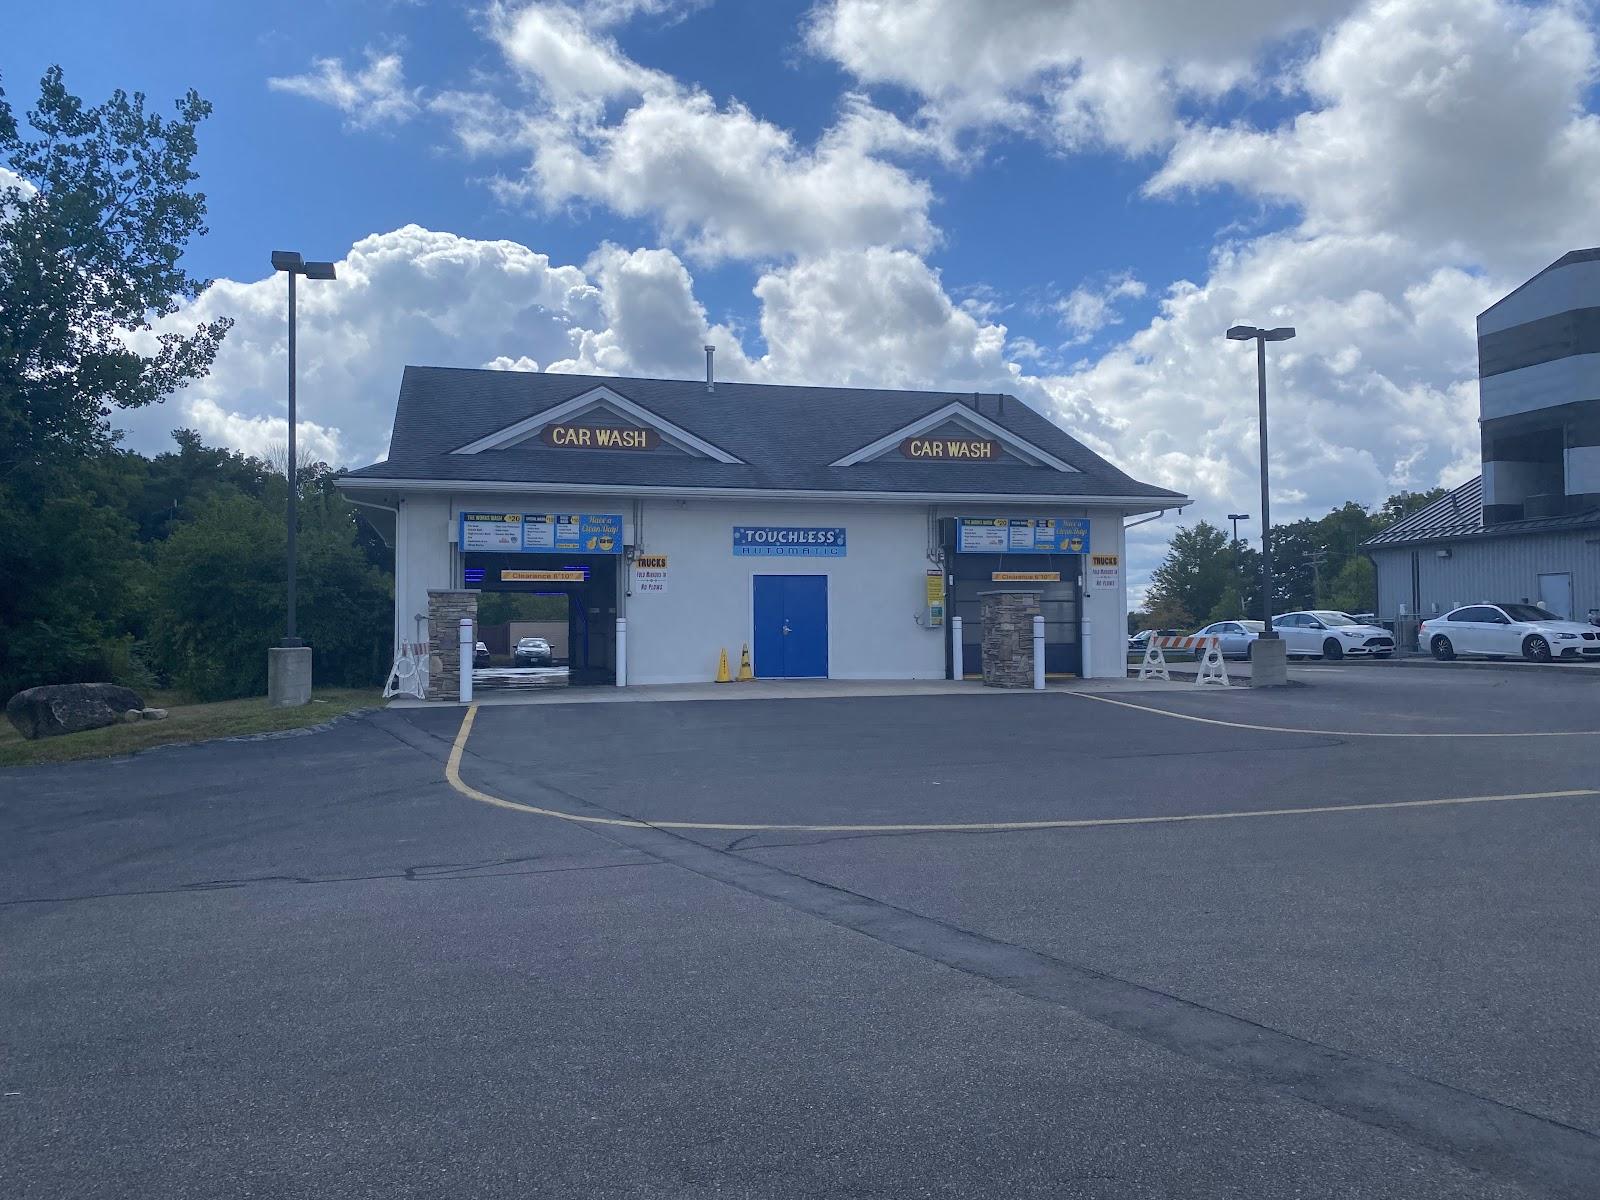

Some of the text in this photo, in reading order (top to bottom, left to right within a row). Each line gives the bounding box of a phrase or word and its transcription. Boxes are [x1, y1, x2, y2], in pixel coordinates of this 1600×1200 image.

[552, 426, 646, 447] CAR WASH
[910, 440, 991, 458] CAR WASH
[590, 515, 606, 524] Have
[745, 530, 835, 543] TOUCHLESS
[742, 547, 838, 555] AUTOMATIC
[637, 557, 666, 568] TRUCKS
[1092, 556, 1118, 566] TRUCKS
